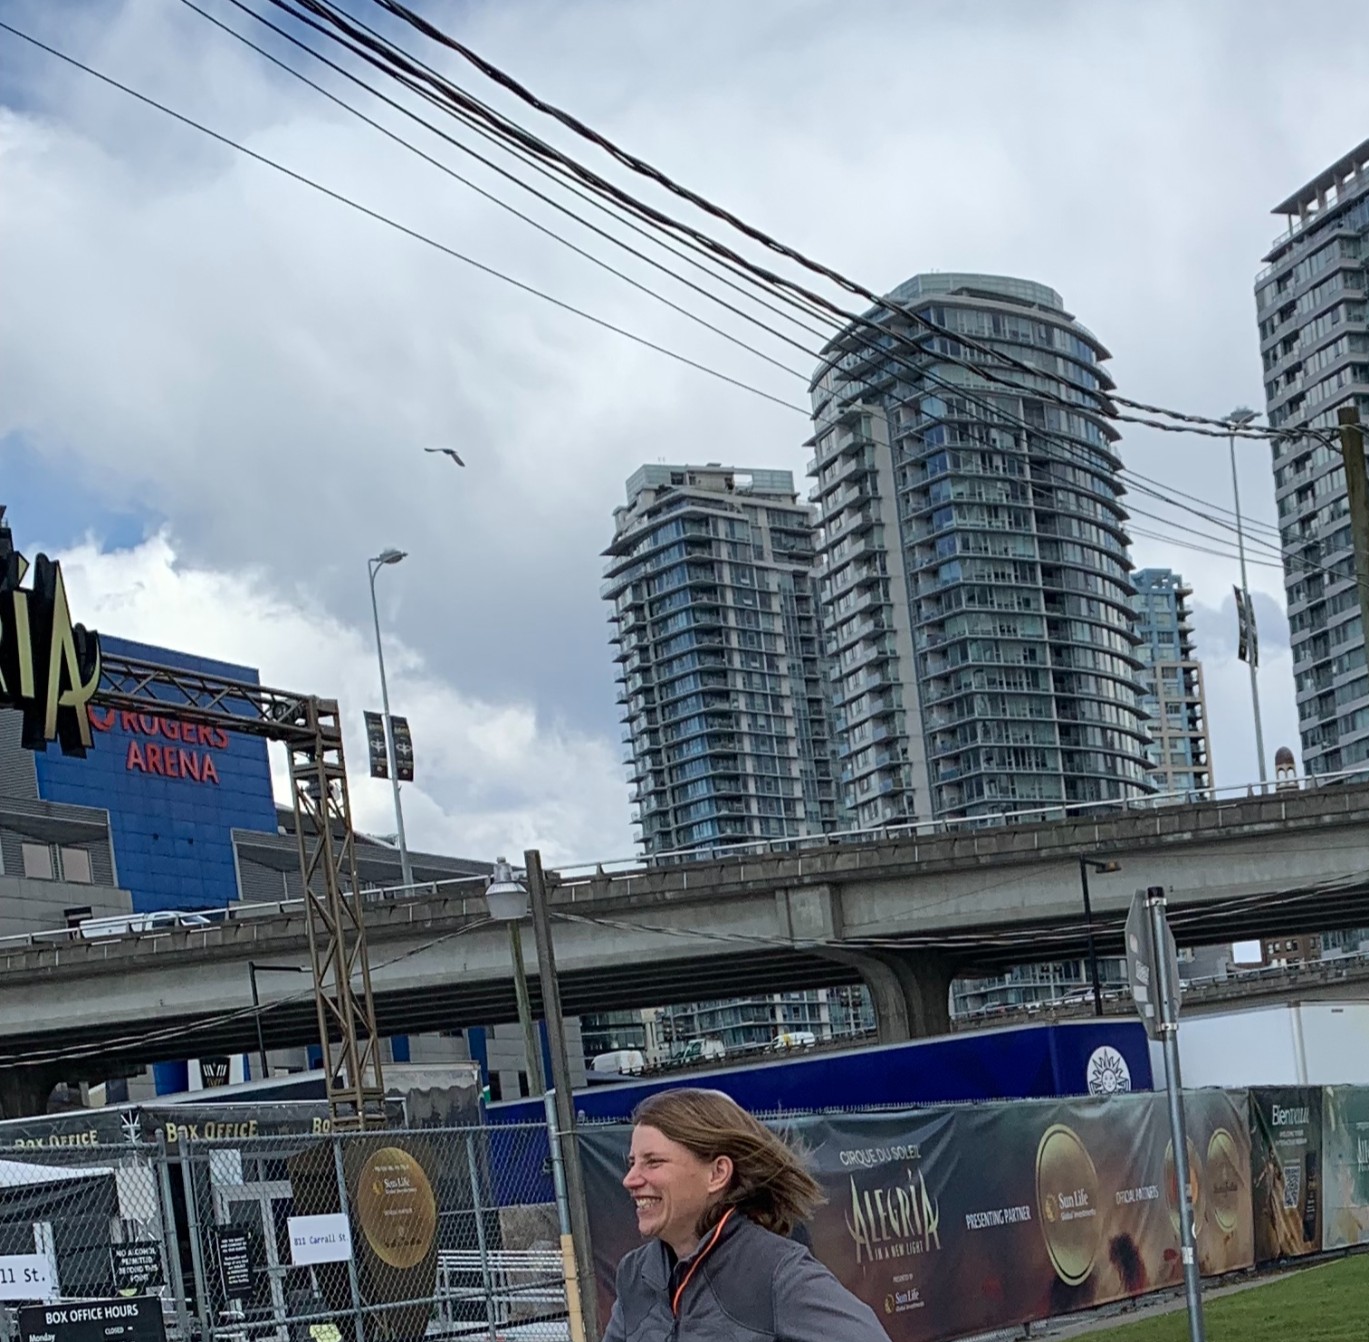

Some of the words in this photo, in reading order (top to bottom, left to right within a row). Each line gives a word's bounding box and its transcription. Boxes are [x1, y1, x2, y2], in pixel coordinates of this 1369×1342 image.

[121, 707, 229, 749] ROGERS
[126, 740, 220, 784] ARENA
[204, 1119, 259, 1138] OFFICE
[312, 1116, 331, 1135] BO
[50, 1129, 98, 1147] OFFICE
[839, 1147, 878, 1168] CIRQUE
[878, 1145, 892, 1161] DU
[892, 1144, 922, 1161] SOLEIL
[1058, 1191, 1075, 1210] Sun
[1073, 1188, 1089, 1208] Life
[965, 1209, 1005, 1230] PRESENTING
[1003, 1205, 1032, 1225] PARTNER
[294, 1237, 306, 1247] 811
[309, 1233, 336, 1245] Carrall
[874, 1247, 883, 1261] IN
[884, 1246, 890, 1259] A
[891, 1243, 905, 1258] NEW
[906, 1240, 924, 1256] LIGHT
[25, 1267, 46, 1283] St.
[895, 1291, 908, 1304] Sun
[907, 1288, 920, 1302] Life
[45, 1310, 68, 1325] BOX
[69, 1307, 103, 1322] OFFICE
[104, 1304, 139, 1319] HOURS
[29, 1332, 56, 1342] Monday
[104, 1326, 124, 1335] CLOSED
